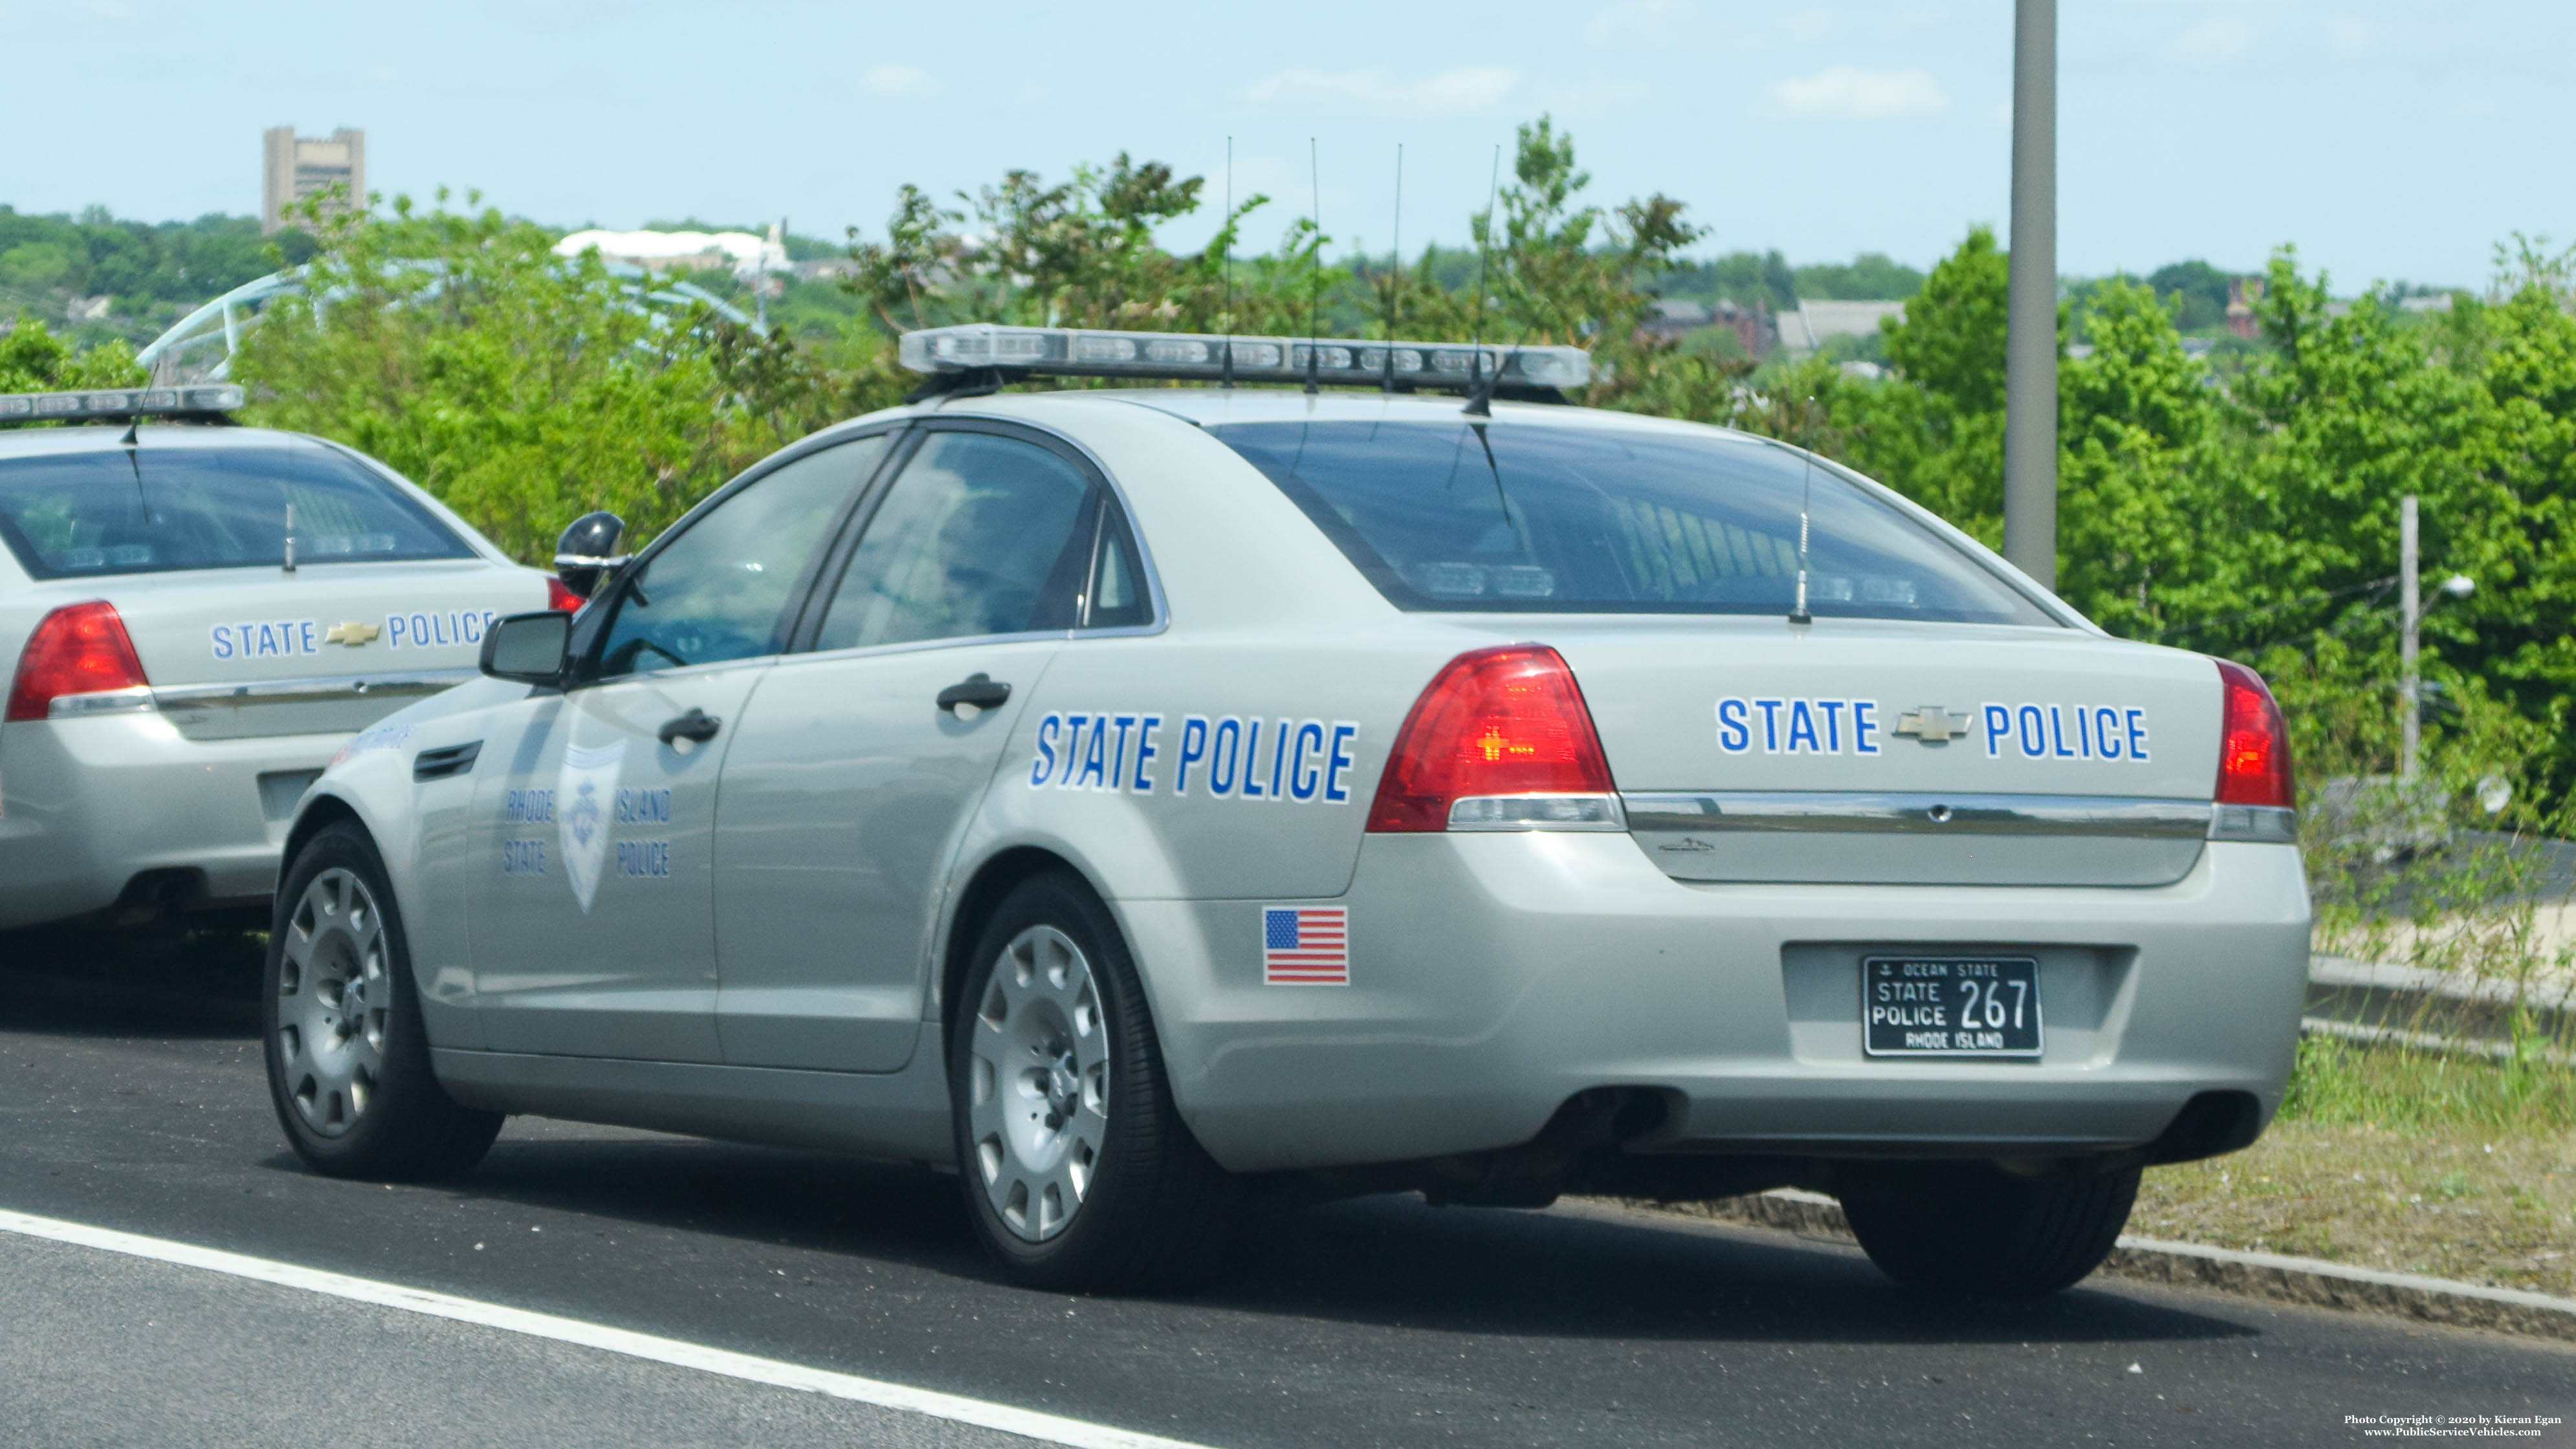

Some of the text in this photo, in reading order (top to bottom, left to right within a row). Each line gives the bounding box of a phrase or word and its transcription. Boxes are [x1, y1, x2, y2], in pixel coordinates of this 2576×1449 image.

[212, 621, 318, 659] STATE
[1717, 697, 2150, 761] STATE POLICE
[1029, 712, 1358, 803] STATE POLICE
[508, 789, 552, 822] RHODE
[503, 840, 668, 877] STATE POLICE
[1904, 964, 1998, 976] OCEAN STATE
[1878, 982, 1940, 1001] STATE
[1960, 980, 2027, 1029] 267
[1873, 1007, 1946, 1025] POLICE
[1906, 1032, 2003, 1048] RHODE ISLAND
